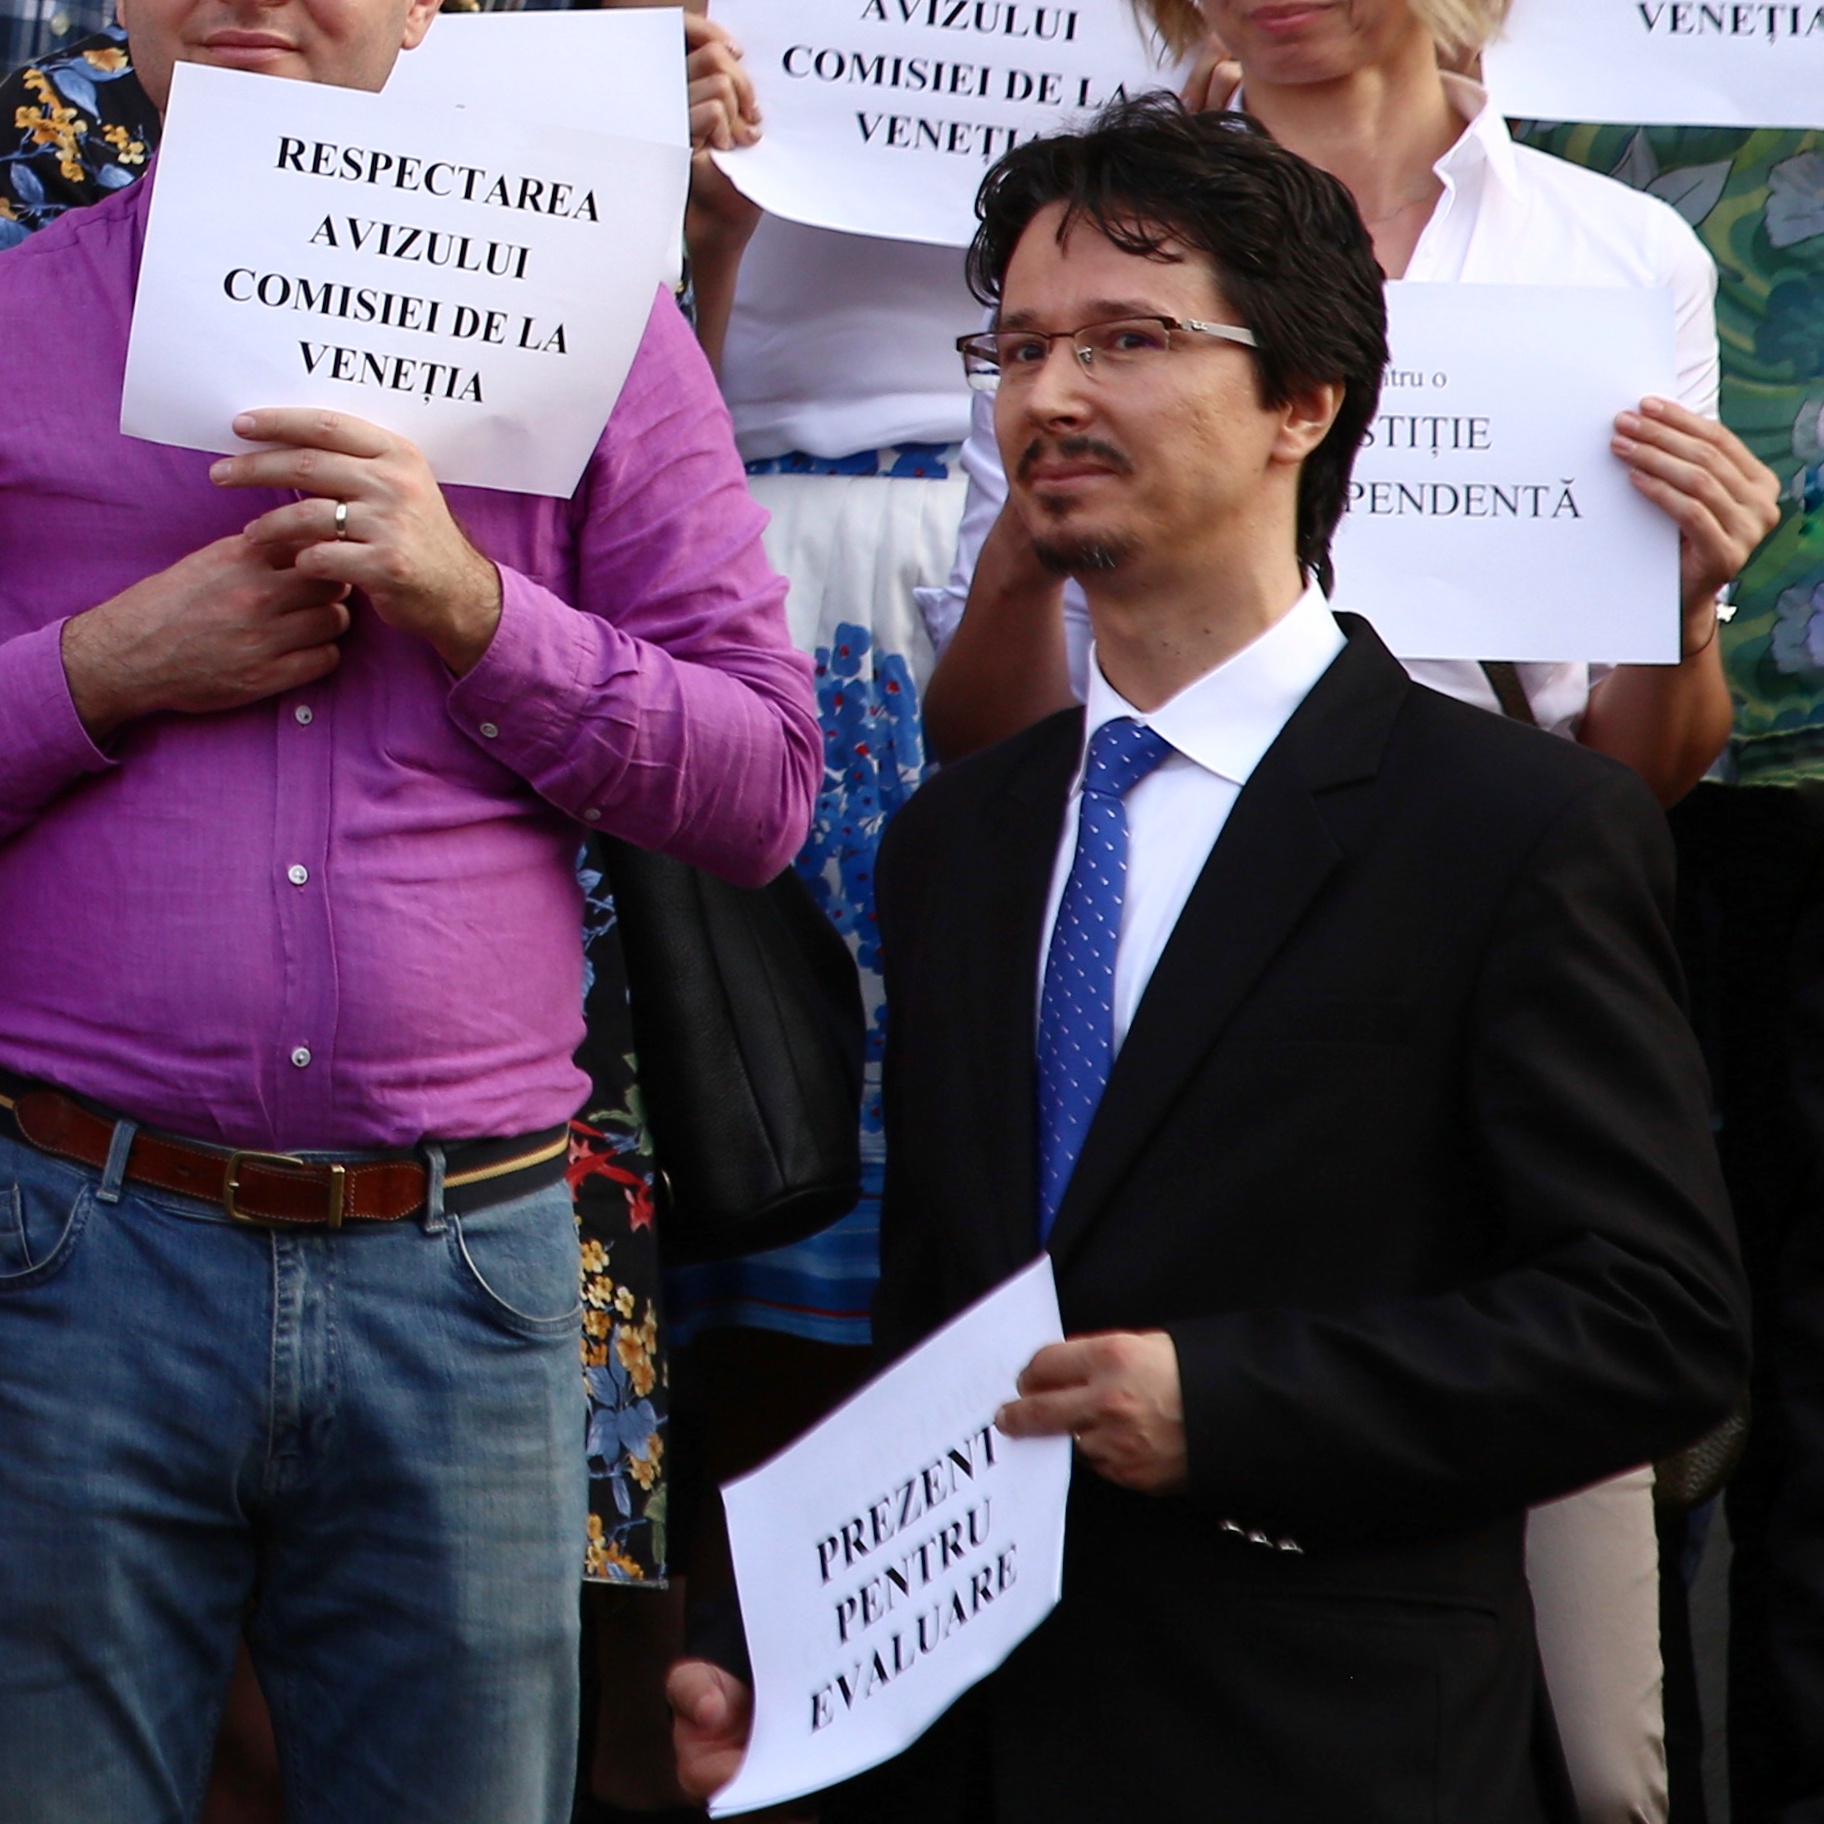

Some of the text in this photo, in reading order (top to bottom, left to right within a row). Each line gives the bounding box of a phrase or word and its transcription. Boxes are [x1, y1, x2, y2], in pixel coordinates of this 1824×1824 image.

[781, 44, 993, 98] COMISIEI
[1004, 70, 1062, 106] DE
[856, 111, 1040, 164] VENEȚI
[274, 135, 601, 224] RESPECTAREA
[308, 214, 532, 281] AVIZULUI
[222, 267, 569, 355] COMISIEI DE LA
[298, 340, 484, 404] VENEȚIA
[1432, 372, 1447, 388] o
[816, 1420, 999, 1587] PREZENT
[834, 1497, 995, 1646] PENTRU
[811, 1546, 1019, 1735] EVALUARE
